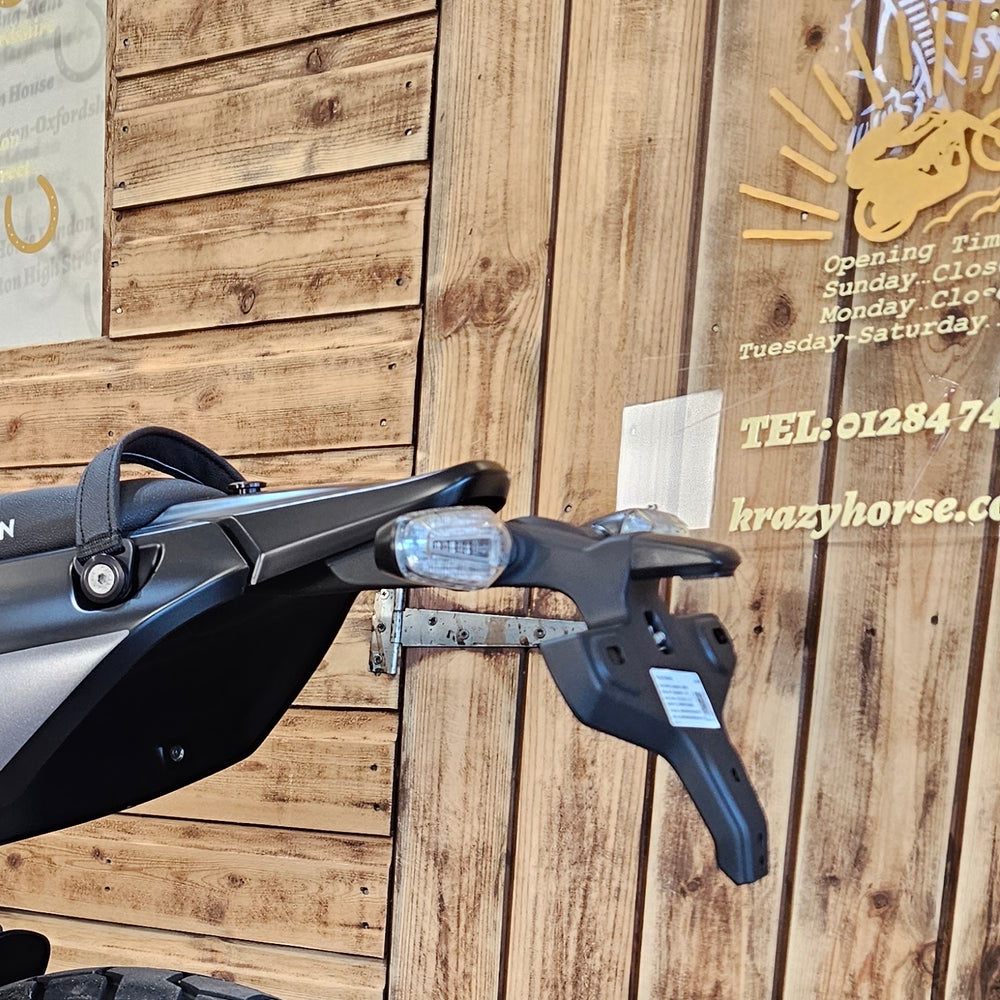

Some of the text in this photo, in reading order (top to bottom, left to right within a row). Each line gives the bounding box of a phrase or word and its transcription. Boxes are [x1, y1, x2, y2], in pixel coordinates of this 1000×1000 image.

[9, 77, 55, 103] House
[824, 232, 1000, 277] Opening Tim
